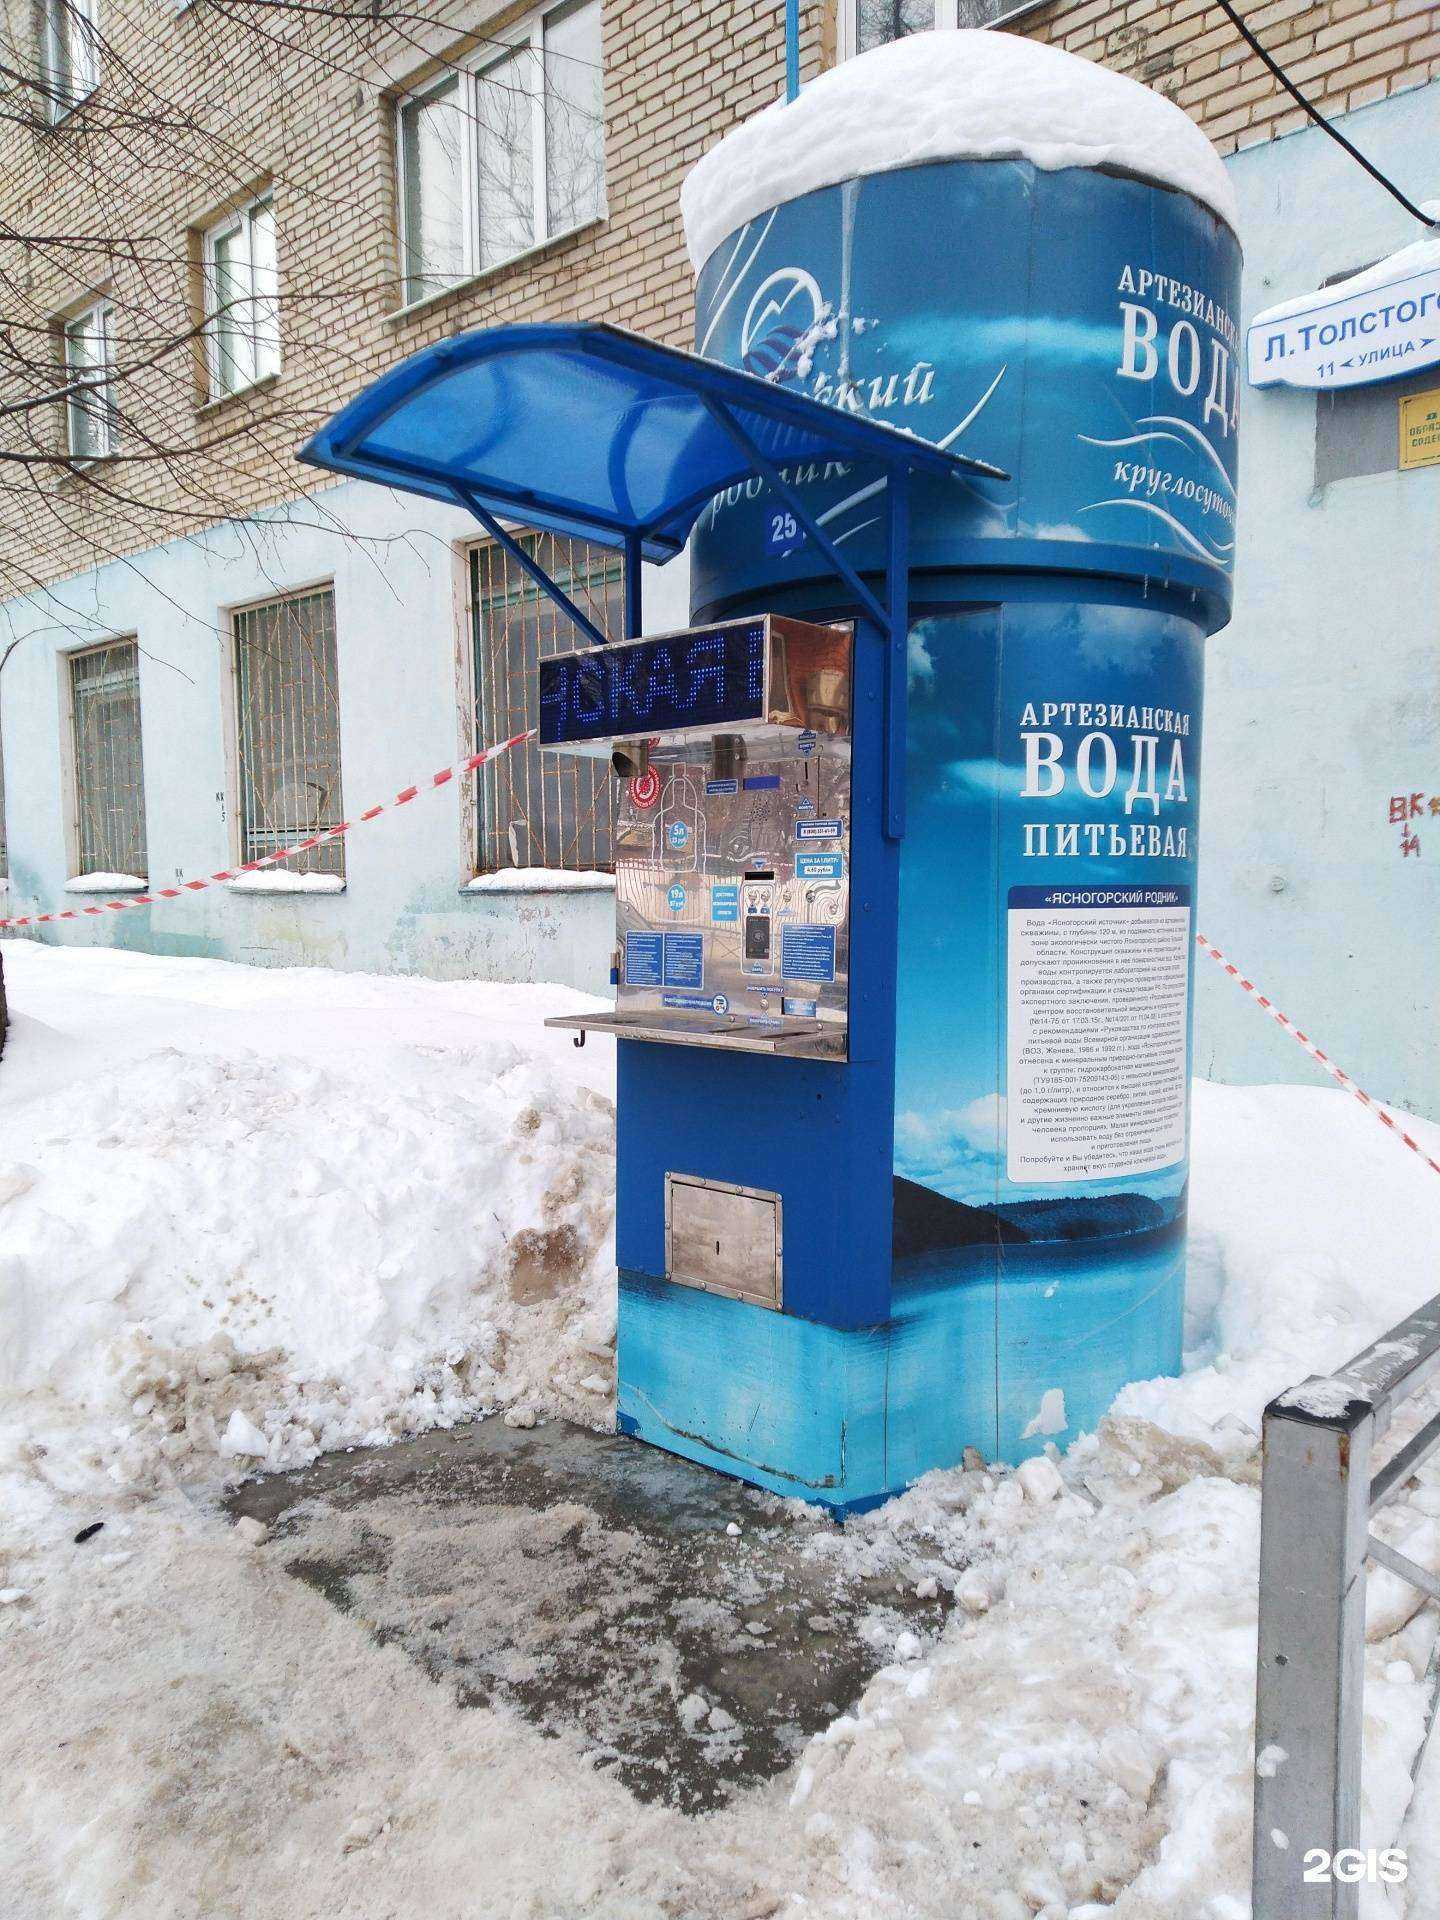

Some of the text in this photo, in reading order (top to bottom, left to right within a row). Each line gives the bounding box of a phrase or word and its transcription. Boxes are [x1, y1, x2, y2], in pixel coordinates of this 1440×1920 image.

[1317, 341, 1415, 378] 11 УЛИЦА
[772, 512, 797, 542] 25
[1020, 702, 1191, 736] АРТЕЗИАНСКАЯ
[1020, 731, 1188, 816] ВОДА
[1022, 823, 1188, 858] ПИТЬЕВАЯ
[1045, 890, 1143, 904] «ЯСНОГОРСКИЙ
[1020, 1156, 1063, 1164] Попробуйте
